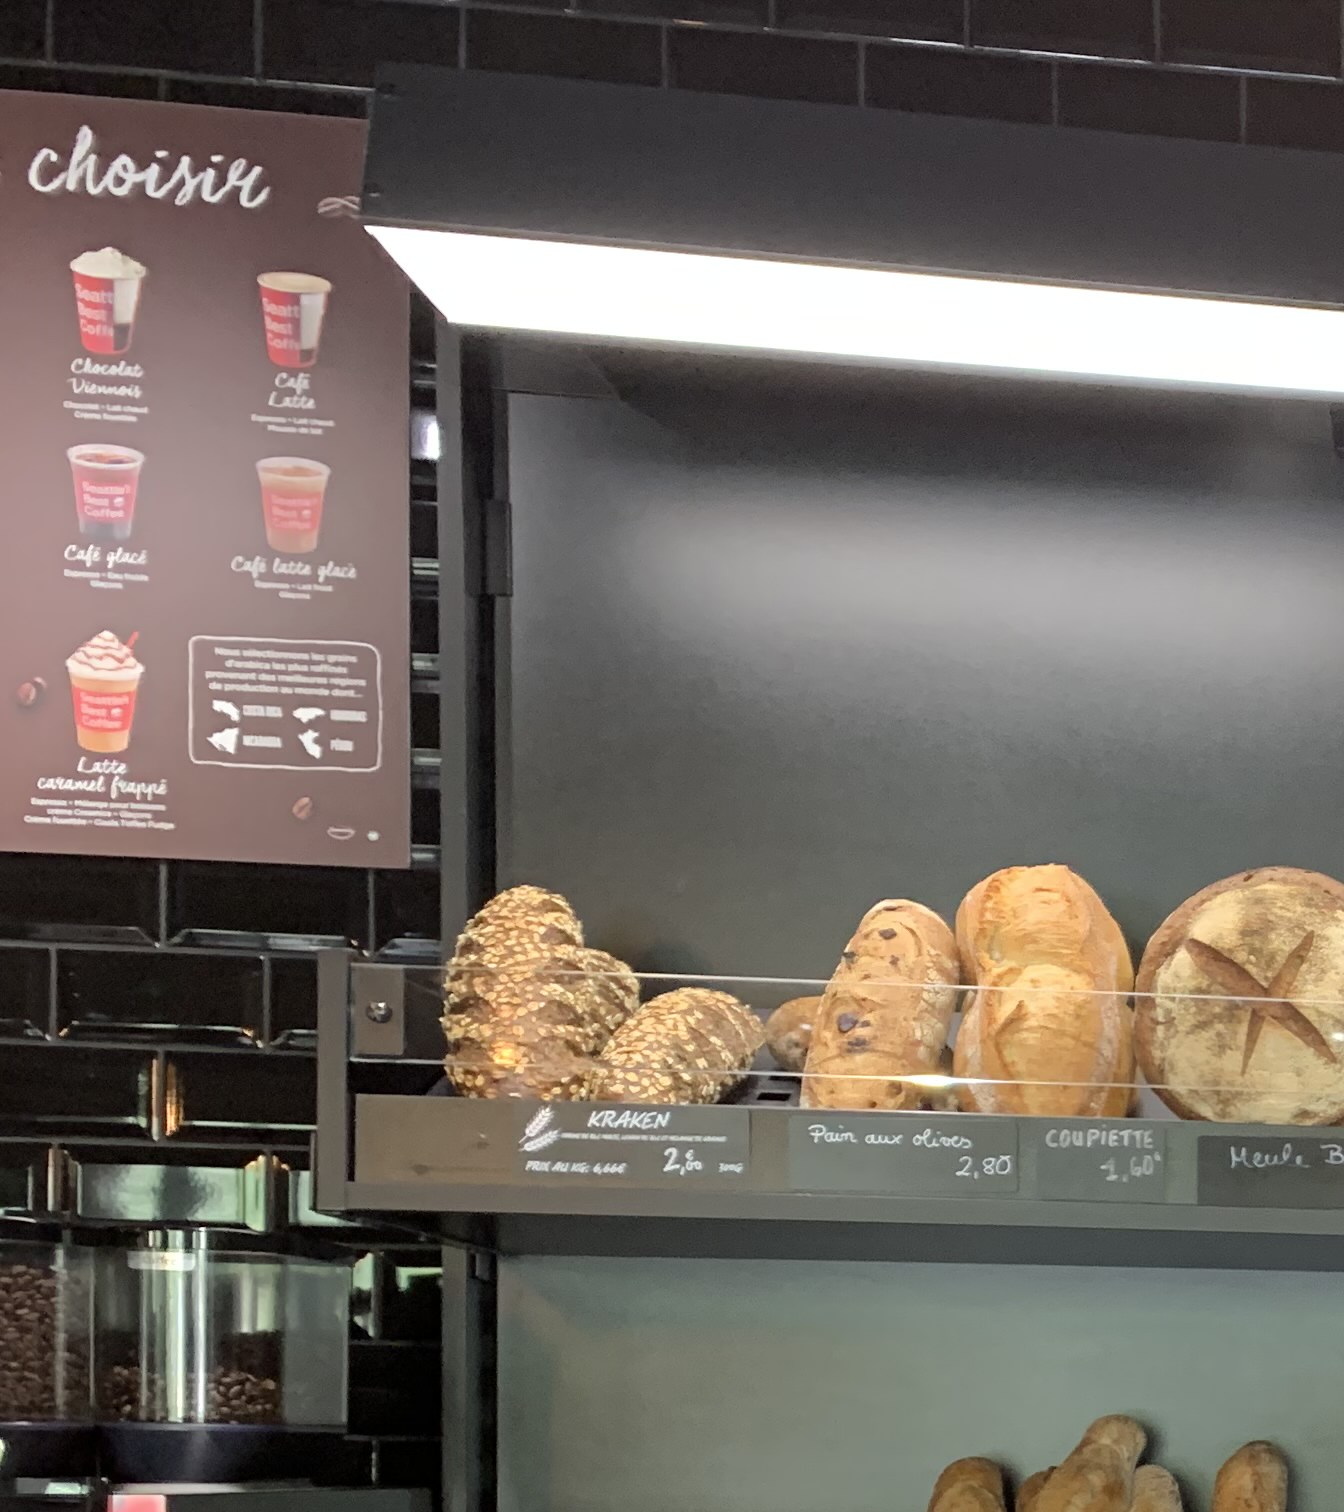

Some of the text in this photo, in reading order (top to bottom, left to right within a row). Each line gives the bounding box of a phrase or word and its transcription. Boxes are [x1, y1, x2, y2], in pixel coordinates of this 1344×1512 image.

[28, 124, 271, 208] choisir
[70, 357, 144, 378] Chocolat
[67, 378, 143, 399] Viennois
[64, 544, 149, 569] Café glacé
[77, 756, 129, 774] Latte
[36, 775, 168, 801] caramel frappé
[587, 1110, 671, 1130] KRAKEN
[808, 1124, 973, 1149] Pain aux olives
[525, 1161, 551, 1172] PRIX
[552, 1162, 569, 1172] AU
[955, 1155, 1012, 1179] 2,80
